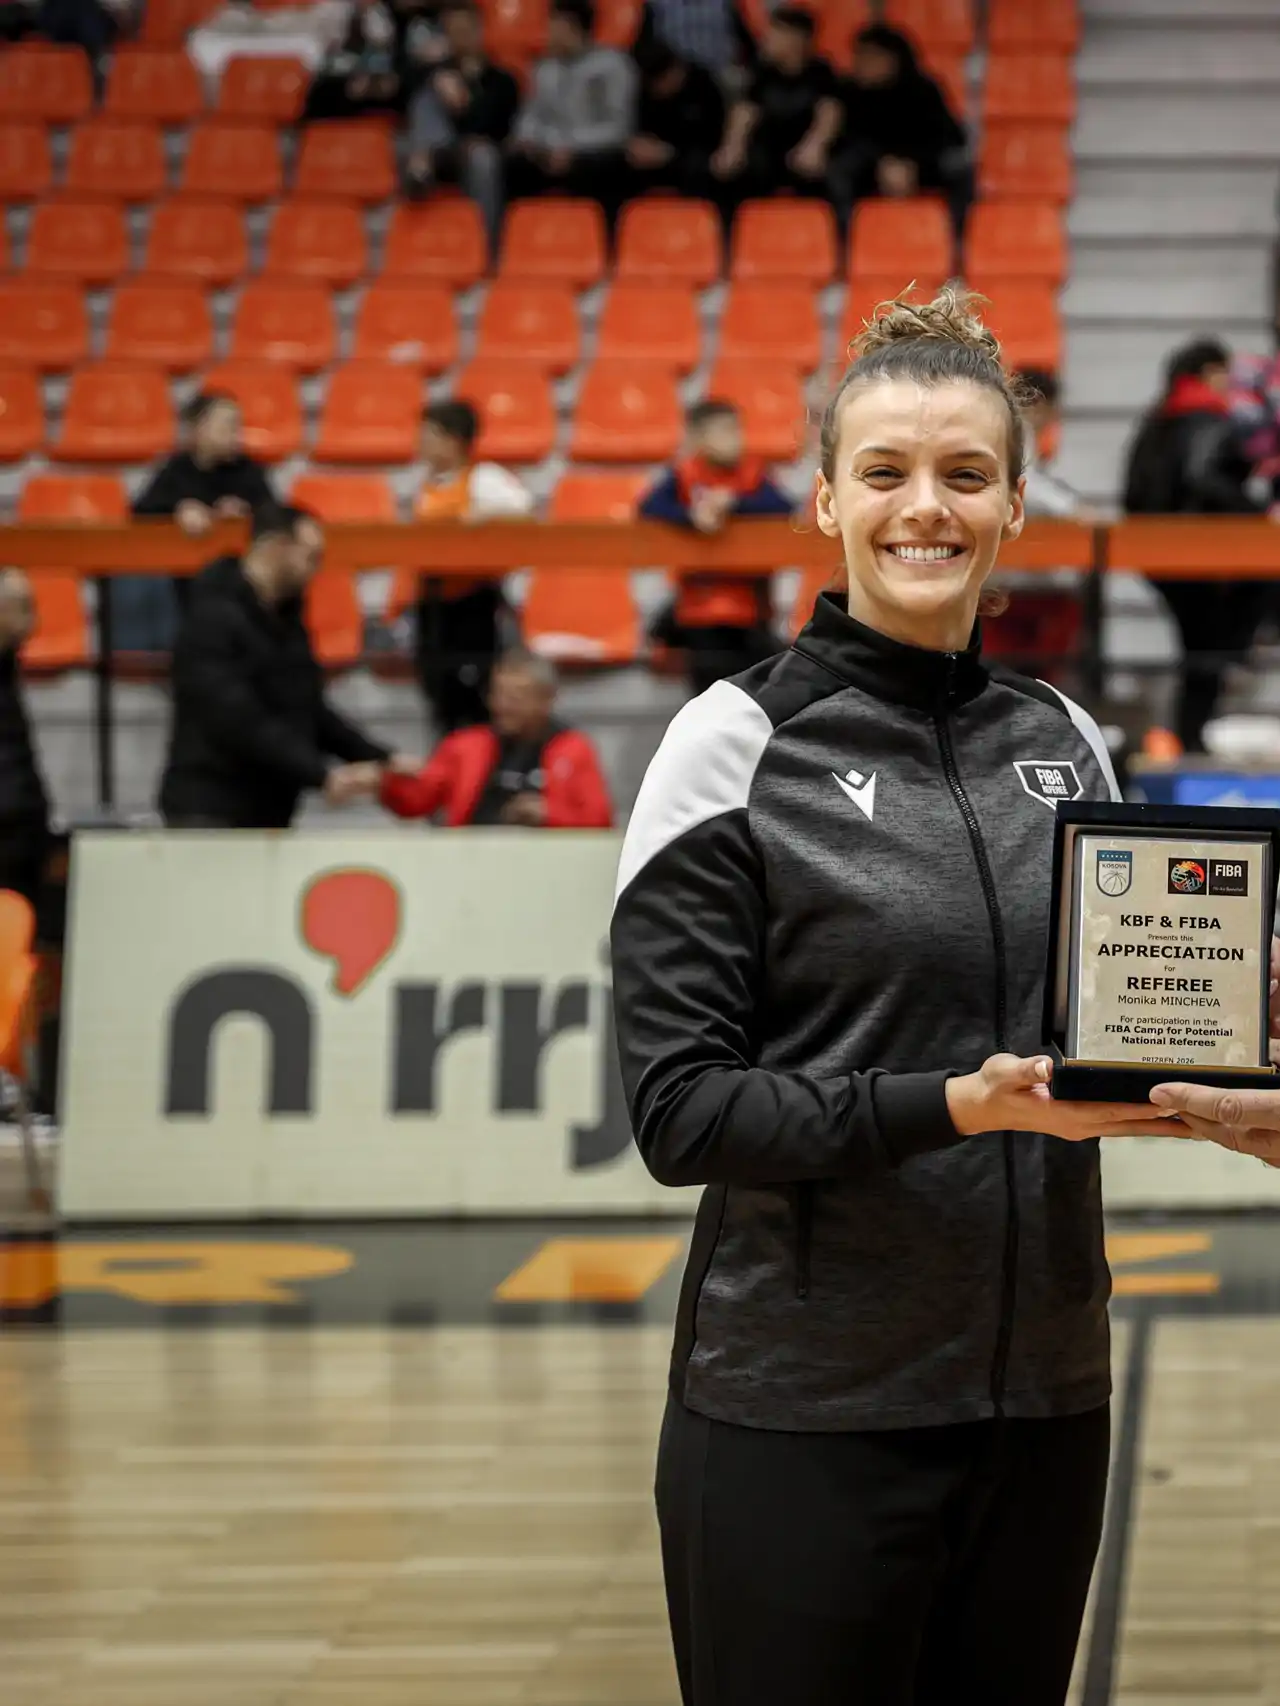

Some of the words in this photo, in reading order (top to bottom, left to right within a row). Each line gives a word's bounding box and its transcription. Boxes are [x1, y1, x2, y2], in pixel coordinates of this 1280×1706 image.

[1034, 768, 1065, 786] FIBA
[1041, 785, 1069, 795] REFEREE
[1215, 864, 1242, 877] FIBA
[1120, 914, 1154, 927] KBF
[1160, 915, 1173, 928] &
[1179, 916, 1222, 929] FIBA
[1148, 933, 1178, 941] Presents
[1180, 934, 1194, 942] this
[1098, 943, 1244, 961] APPRECIATION
[1127, 976, 1213, 992] REFEREE
[1118, 994, 1157, 1005] Monika
[1161, 996, 1221, 1007] MINCHEVA
[1120, 1015, 1134, 1024] For
[1136, 1016, 1190, 1026] participation
[1203, 1018, 1218, 1026] the
[1105, 1024, 1131, 1033] FIBA
[1134, 1025, 1164, 1036] Camp
[1167, 1026, 1182, 1035] for
[1185, 1027, 1233, 1037] Potential
[1121, 1036, 1166, 1045] National
[1169, 1037, 1216, 1047] Referees
[1176, 1057, 1195, 1065] 2026
